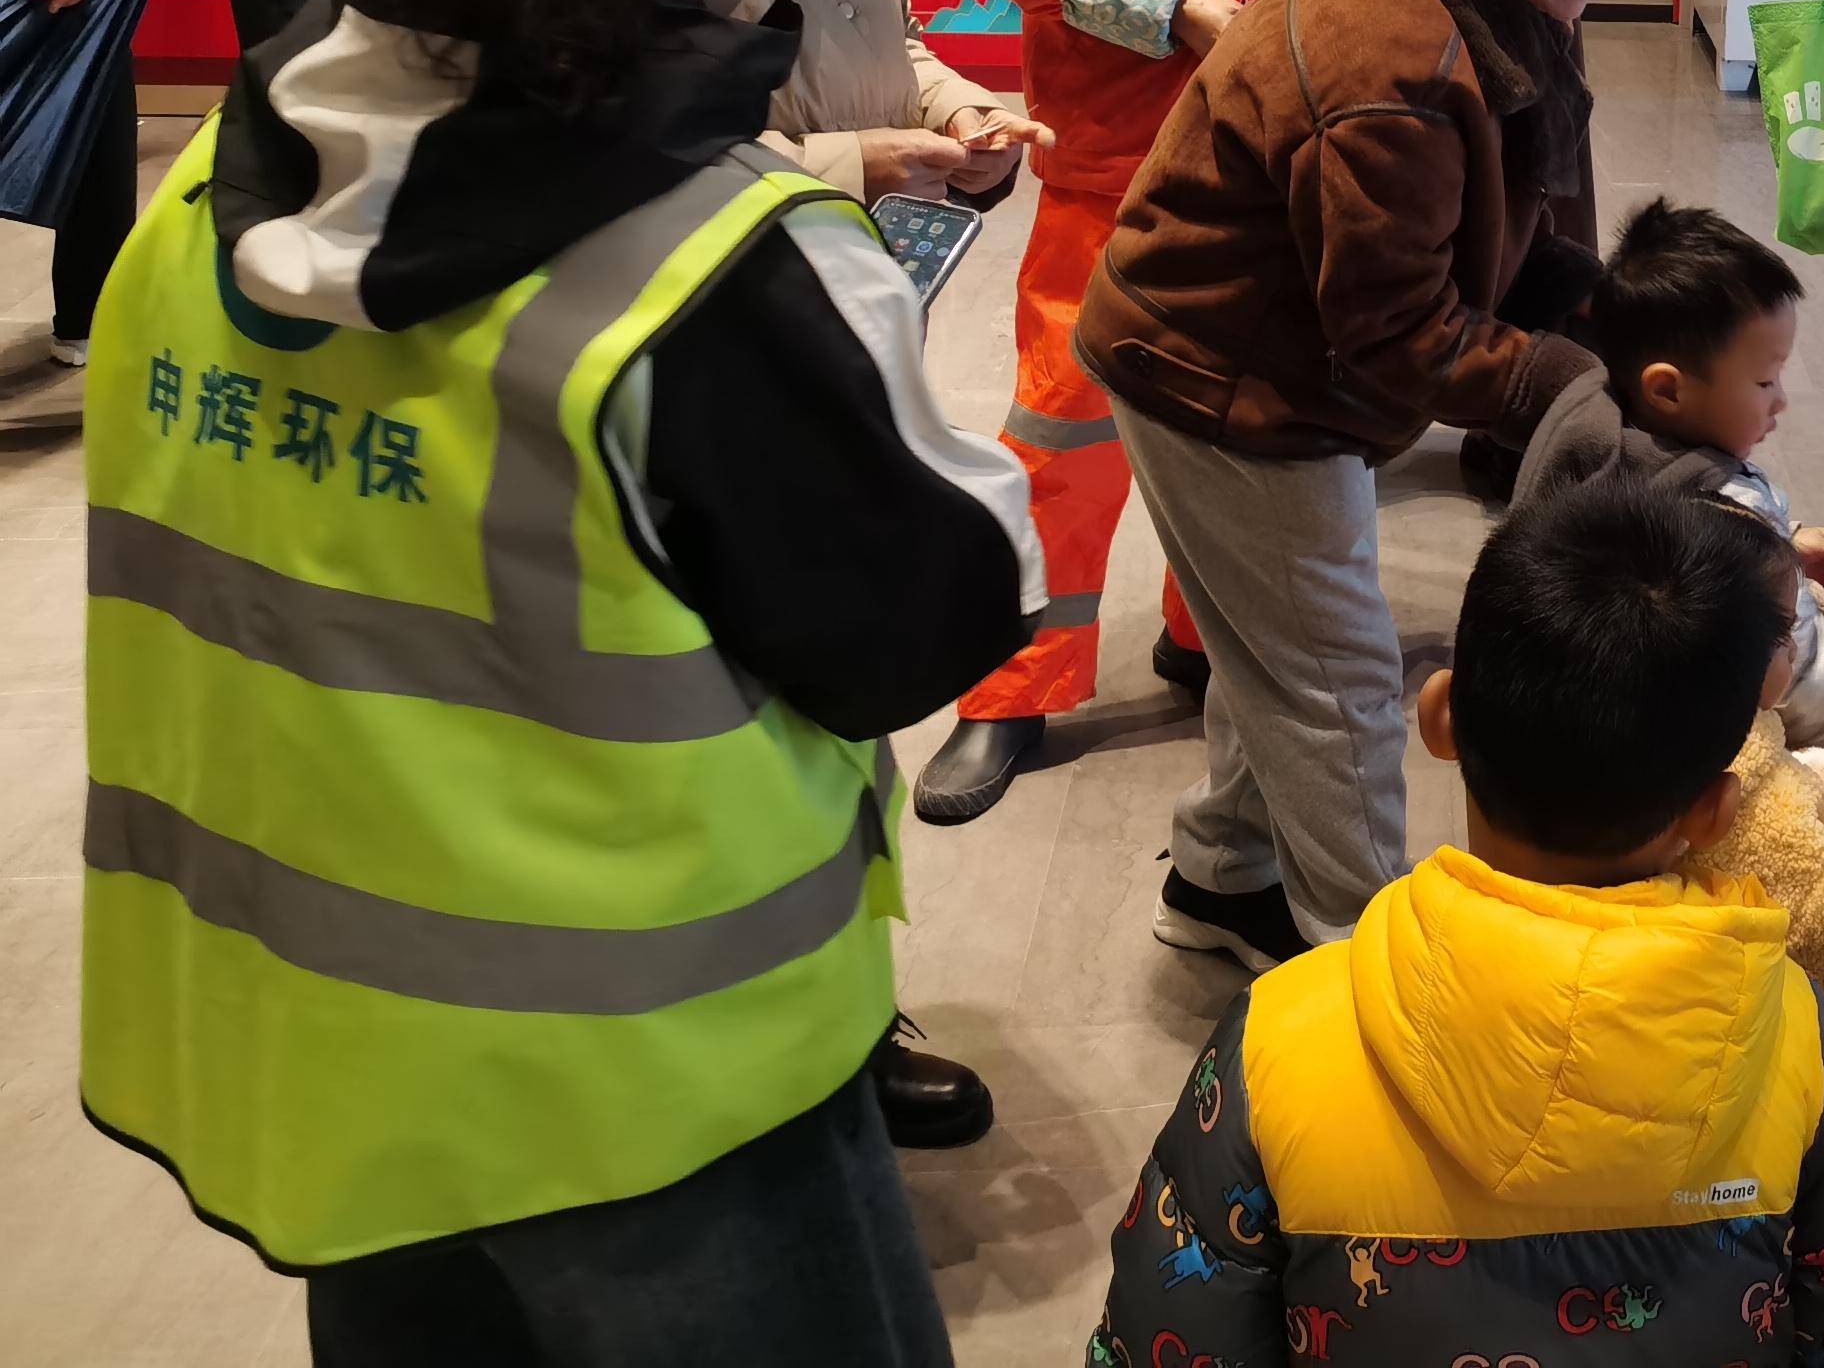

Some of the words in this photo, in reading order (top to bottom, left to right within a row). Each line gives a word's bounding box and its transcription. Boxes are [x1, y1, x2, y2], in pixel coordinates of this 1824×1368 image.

[147, 347, 429, 504] 申辉环保
[1711, 1183, 1756, 1202] home
